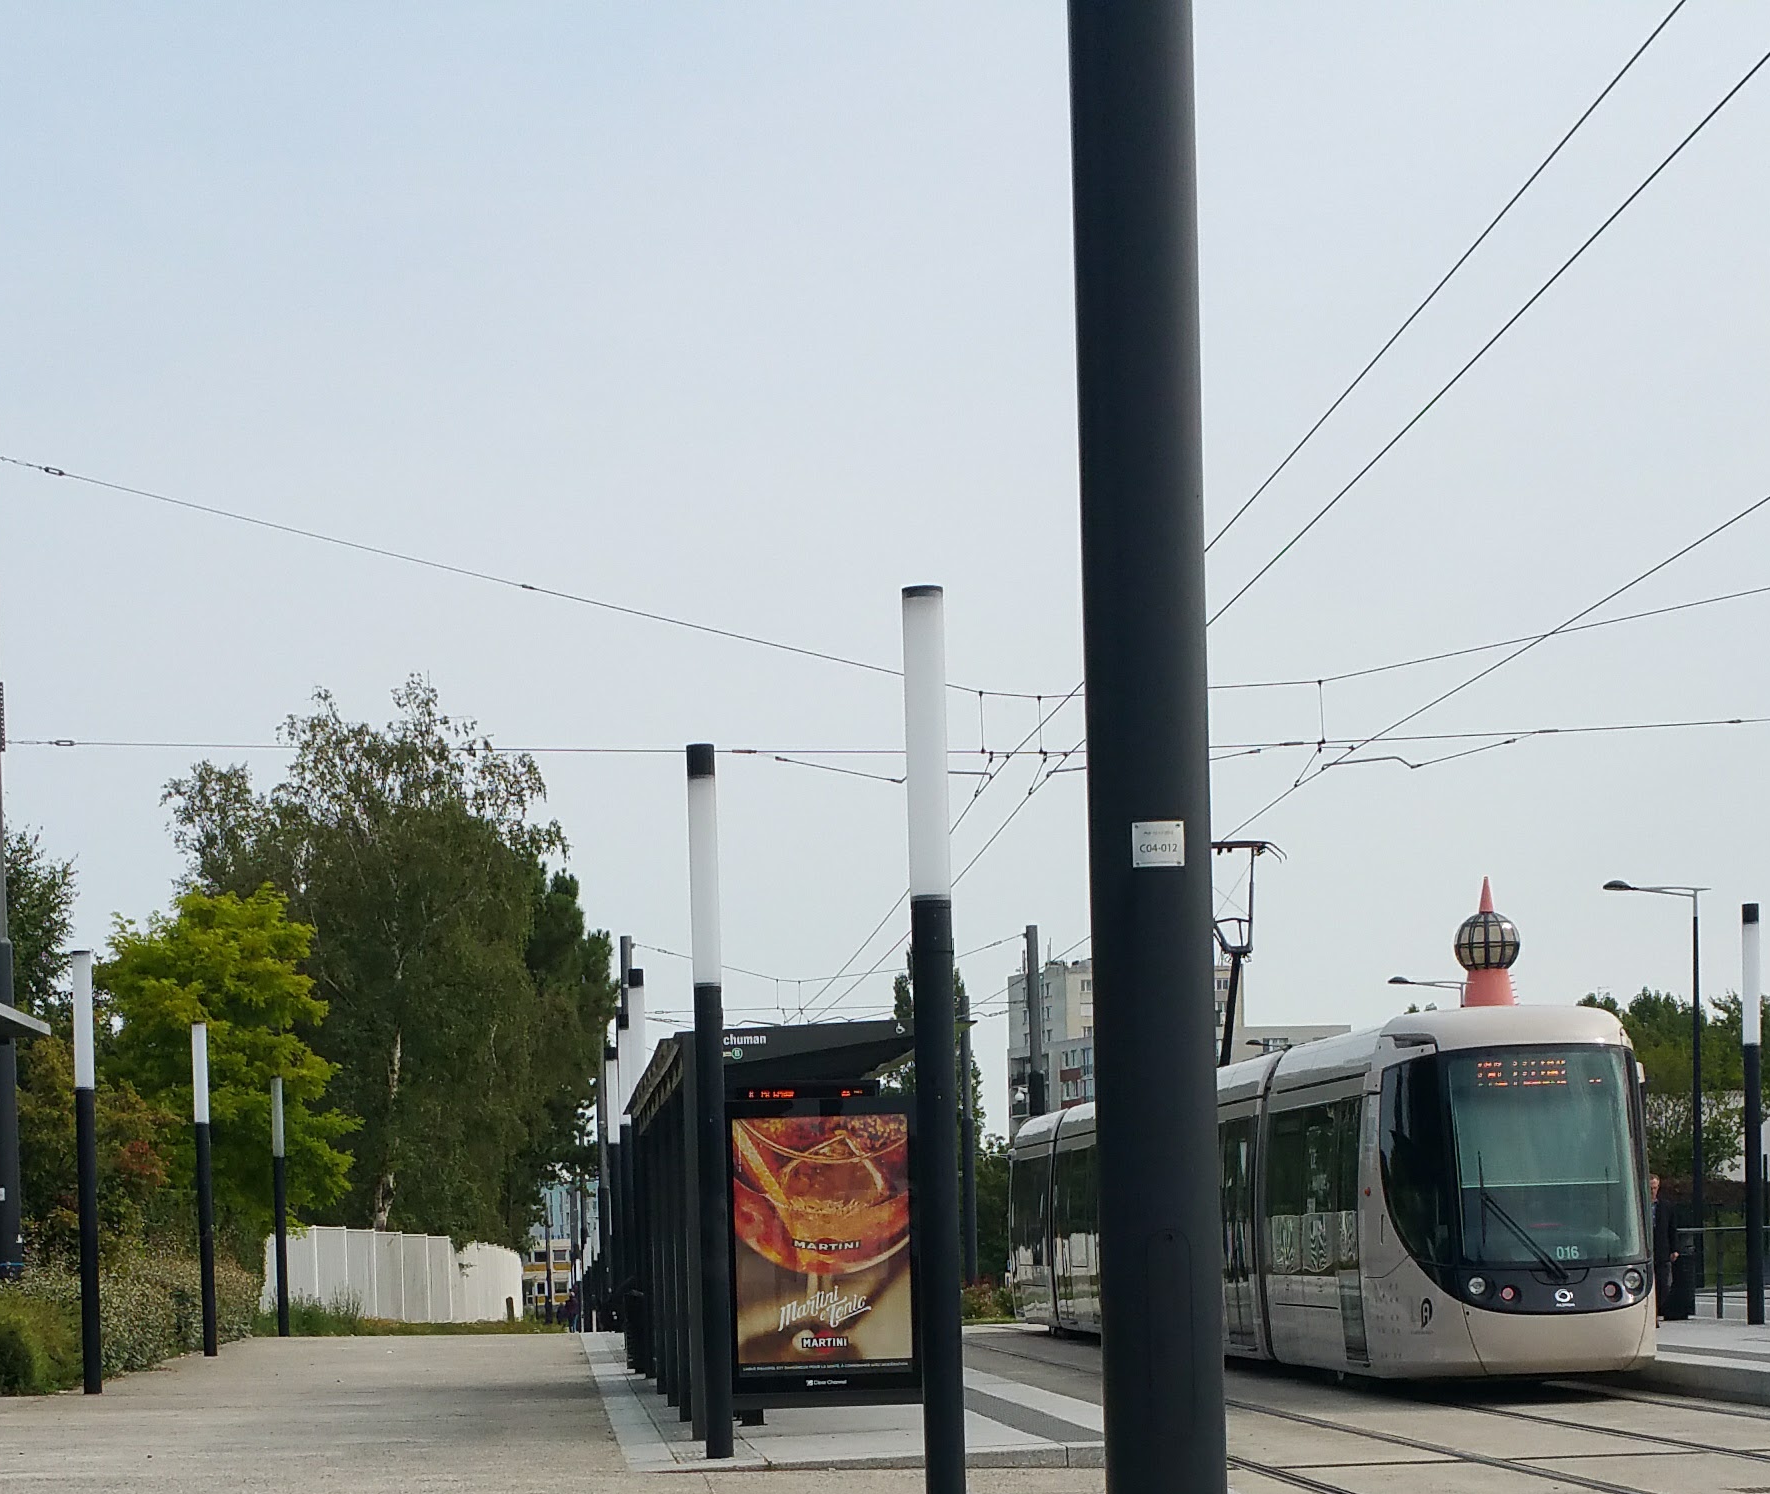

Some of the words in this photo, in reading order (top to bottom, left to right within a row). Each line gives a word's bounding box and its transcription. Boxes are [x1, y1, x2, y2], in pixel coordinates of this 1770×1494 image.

[723, 1033, 767, 1046] chuman
[794, 1240, 860, 1251] MARTINI
[1556, 1245, 1579, 1259] 016
[778, 1285, 839, 1332] Martini
[826, 1293, 872, 1328] Tonic
[803, 1337, 848, 1347] MARTINI
